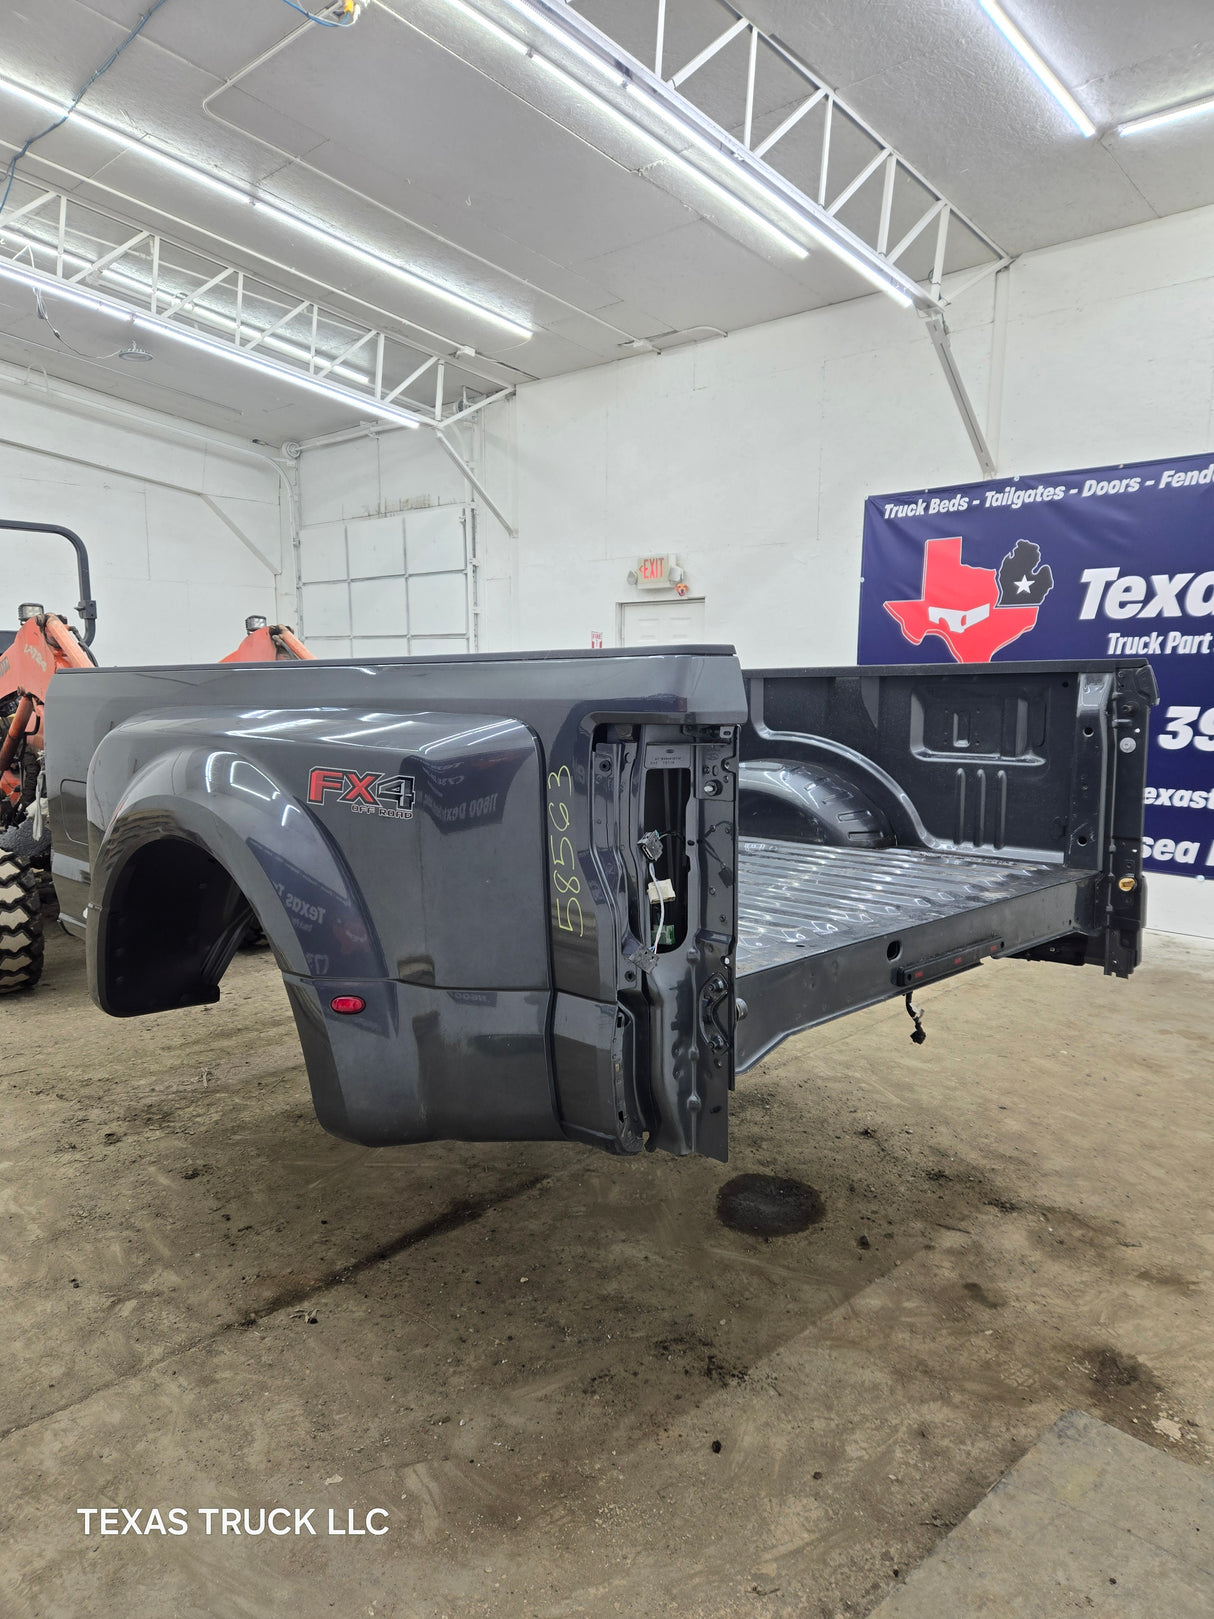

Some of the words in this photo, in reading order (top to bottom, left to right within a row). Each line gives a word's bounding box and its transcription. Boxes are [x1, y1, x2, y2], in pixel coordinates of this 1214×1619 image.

[884, 499, 928, 519] Truck
[928, 494, 969, 515] Beds
[985, 485, 1065, 509] Tailgates
[1081, 476, 1142, 498] Doors
[643, 558, 665, 580] EXIT
[1107, 631, 1164, 655] Truck
[1164, 631, 1214, 655] Part
[307, 766, 415, 811] FX4
[351, 804, 376, 815] OFF
[379, 807, 414, 820] ROAD
